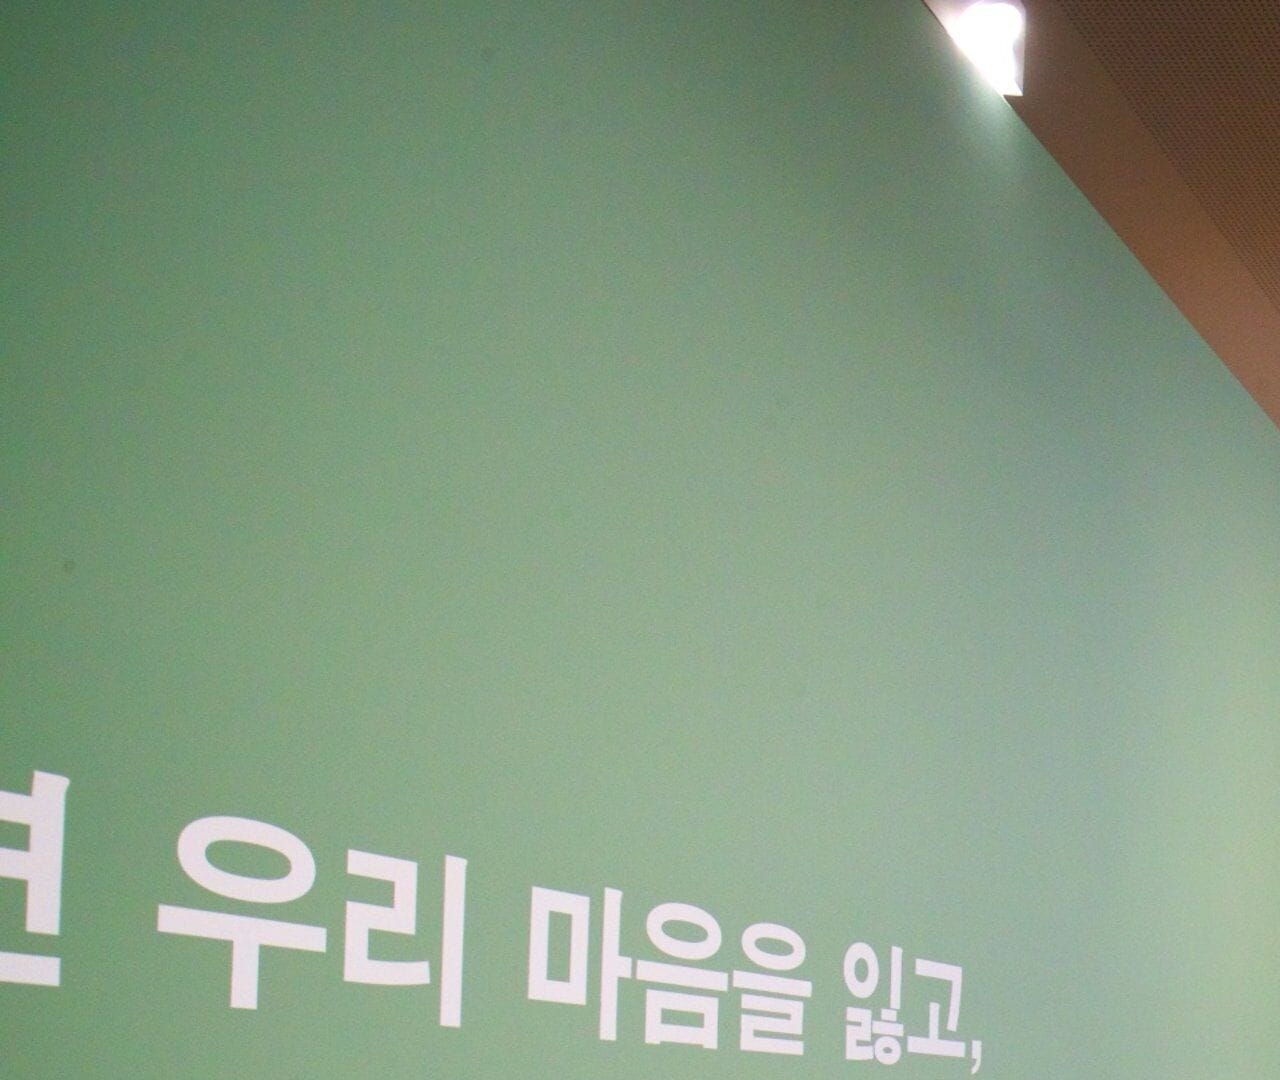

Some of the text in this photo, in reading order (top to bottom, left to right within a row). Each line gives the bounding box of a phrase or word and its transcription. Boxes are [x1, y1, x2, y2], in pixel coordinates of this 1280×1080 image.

[157, 816, 468, 1028] 우리
[528, 886, 812, 1056] 마음을
[844, 942, 982, 1074] 잃고,
